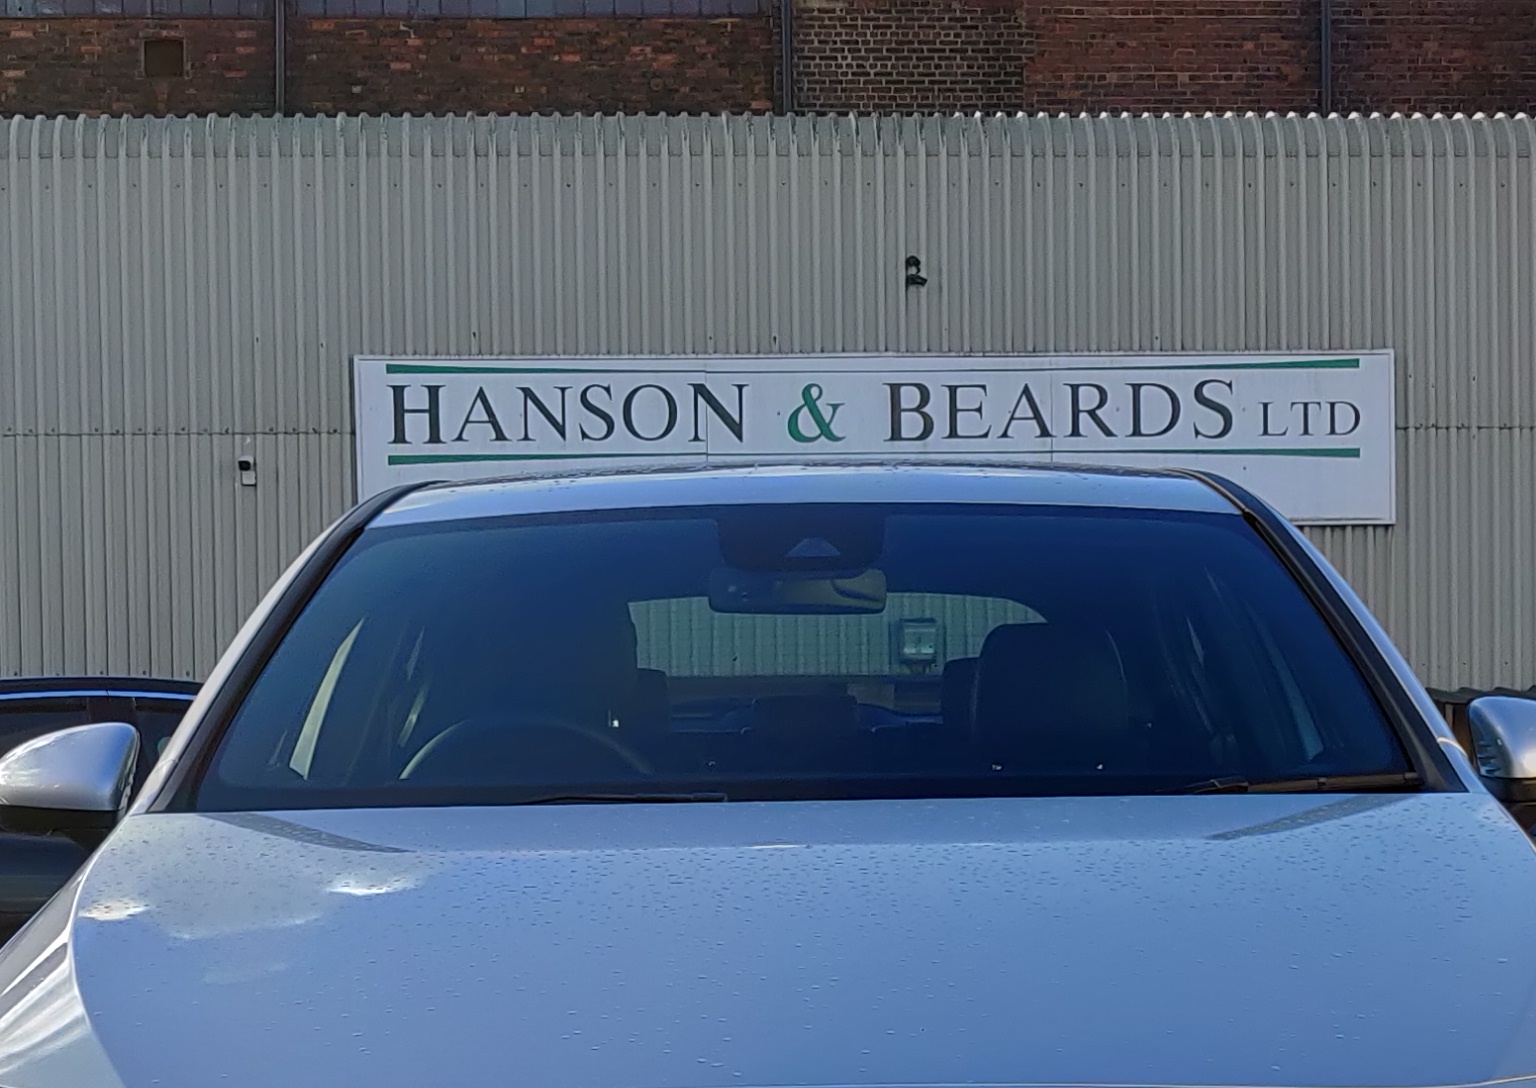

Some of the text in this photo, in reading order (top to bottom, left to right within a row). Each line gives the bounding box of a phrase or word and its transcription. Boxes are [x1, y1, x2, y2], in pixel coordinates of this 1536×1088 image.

[386, 378, 1361, 445] HANSON & BEARDS LTD
